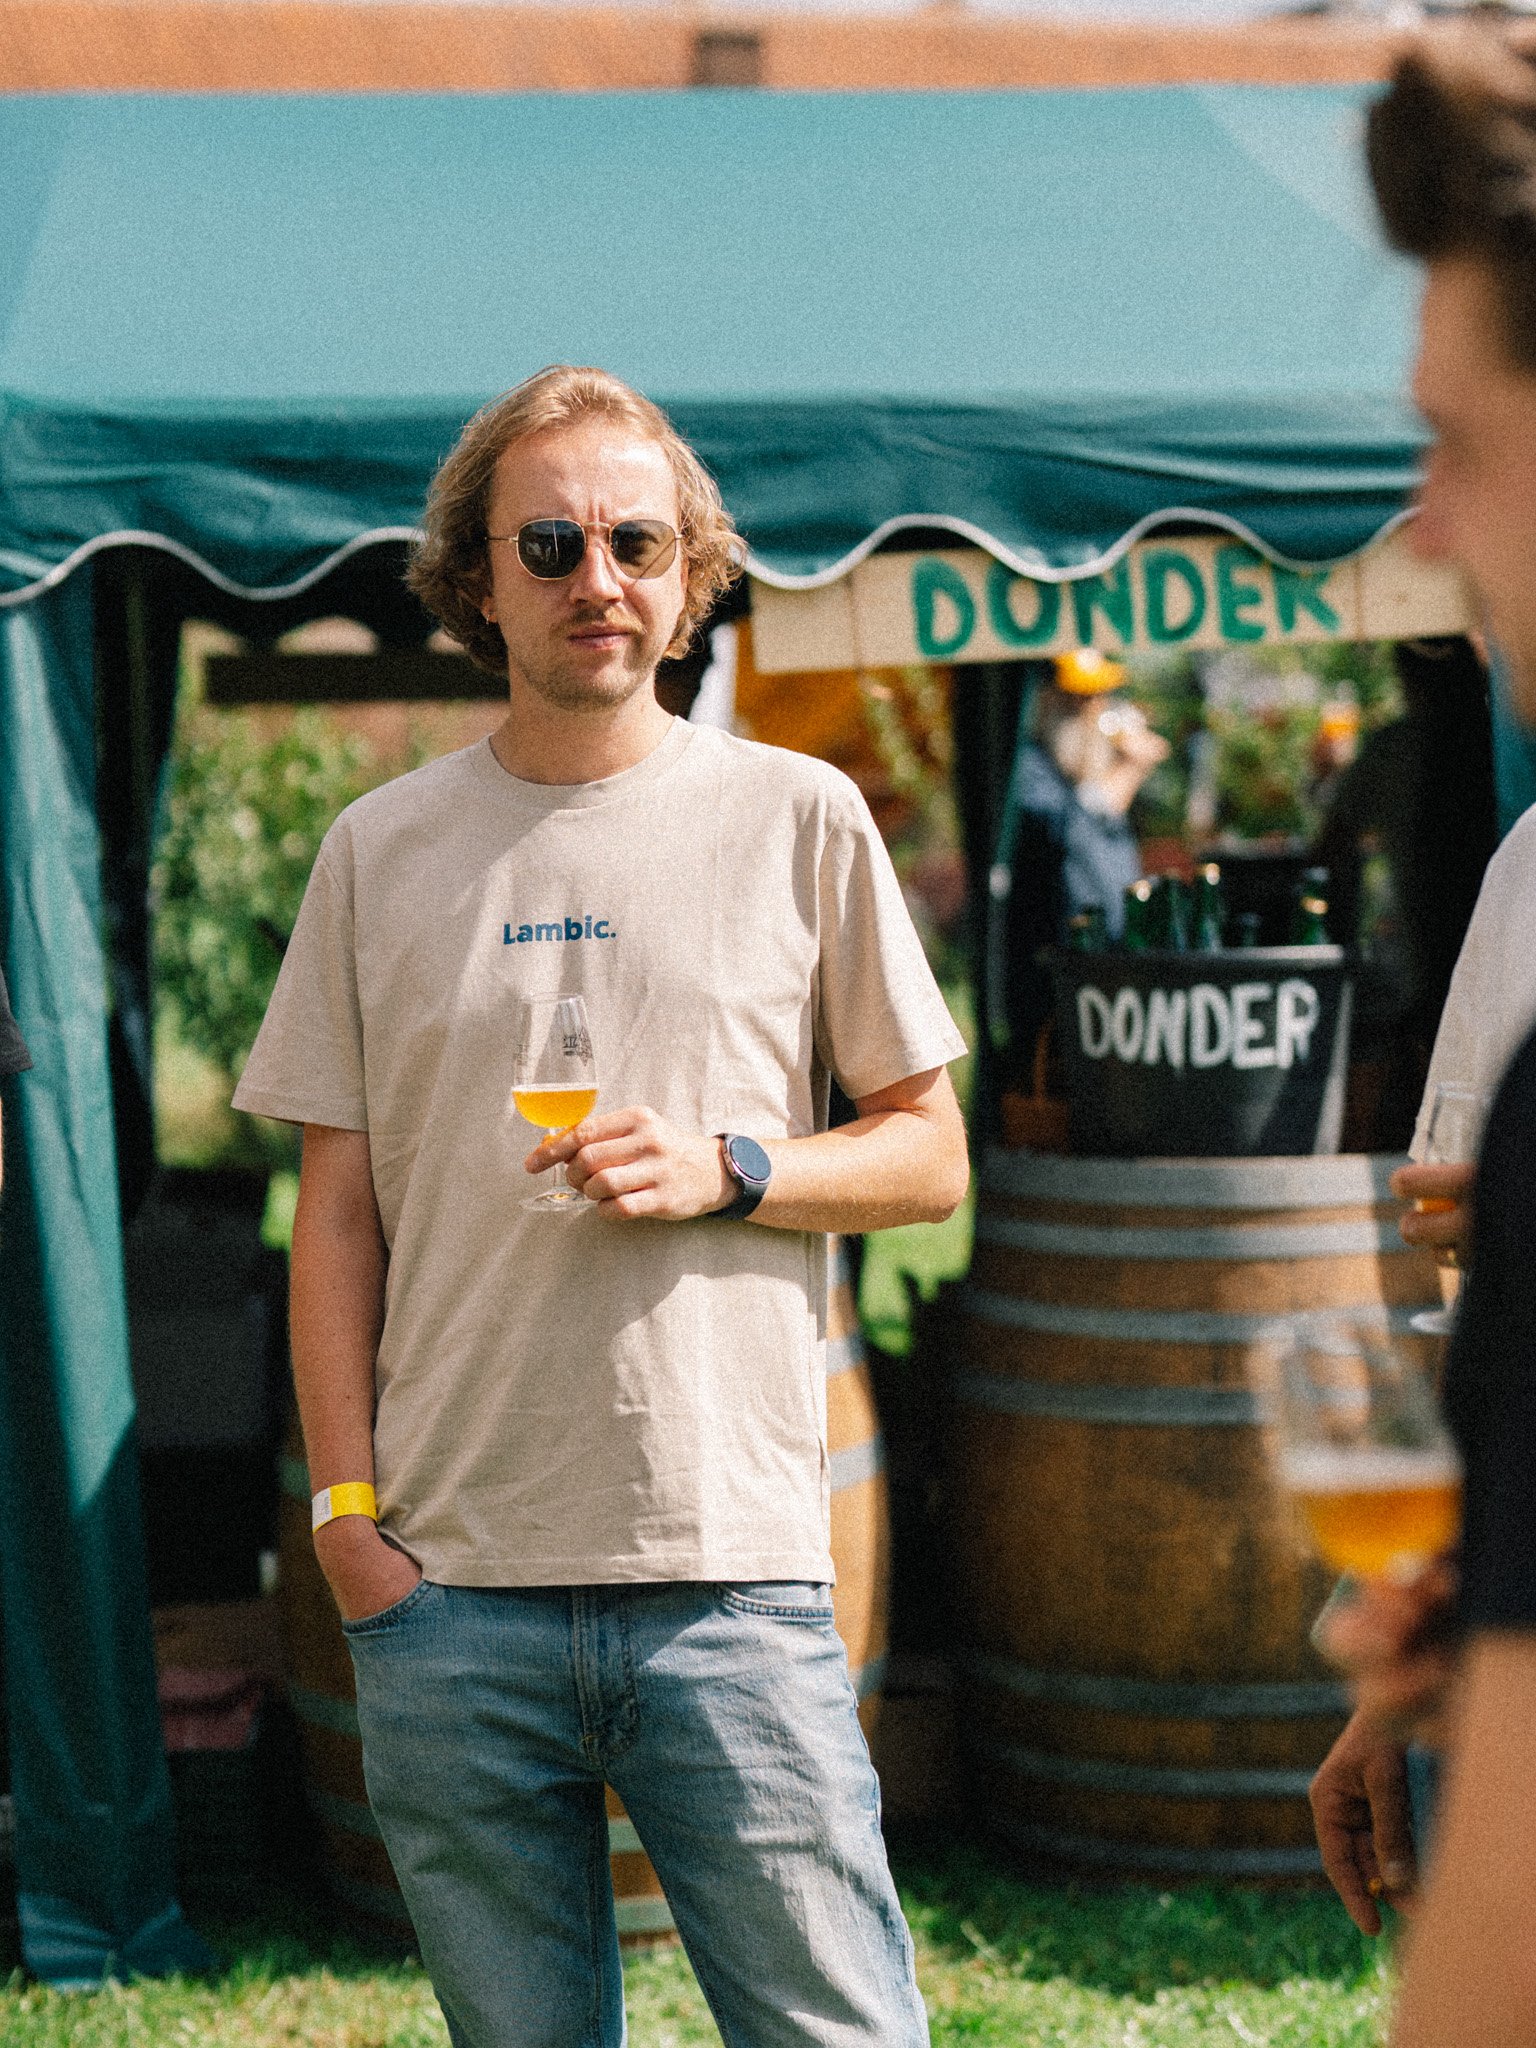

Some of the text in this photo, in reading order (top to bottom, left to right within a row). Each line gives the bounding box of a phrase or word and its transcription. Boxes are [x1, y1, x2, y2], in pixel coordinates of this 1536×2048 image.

[912, 546, 1340, 657] DONDER
[503, 915, 616, 944] Lambic.
[1077, 979, 1318, 1070] DONDER
